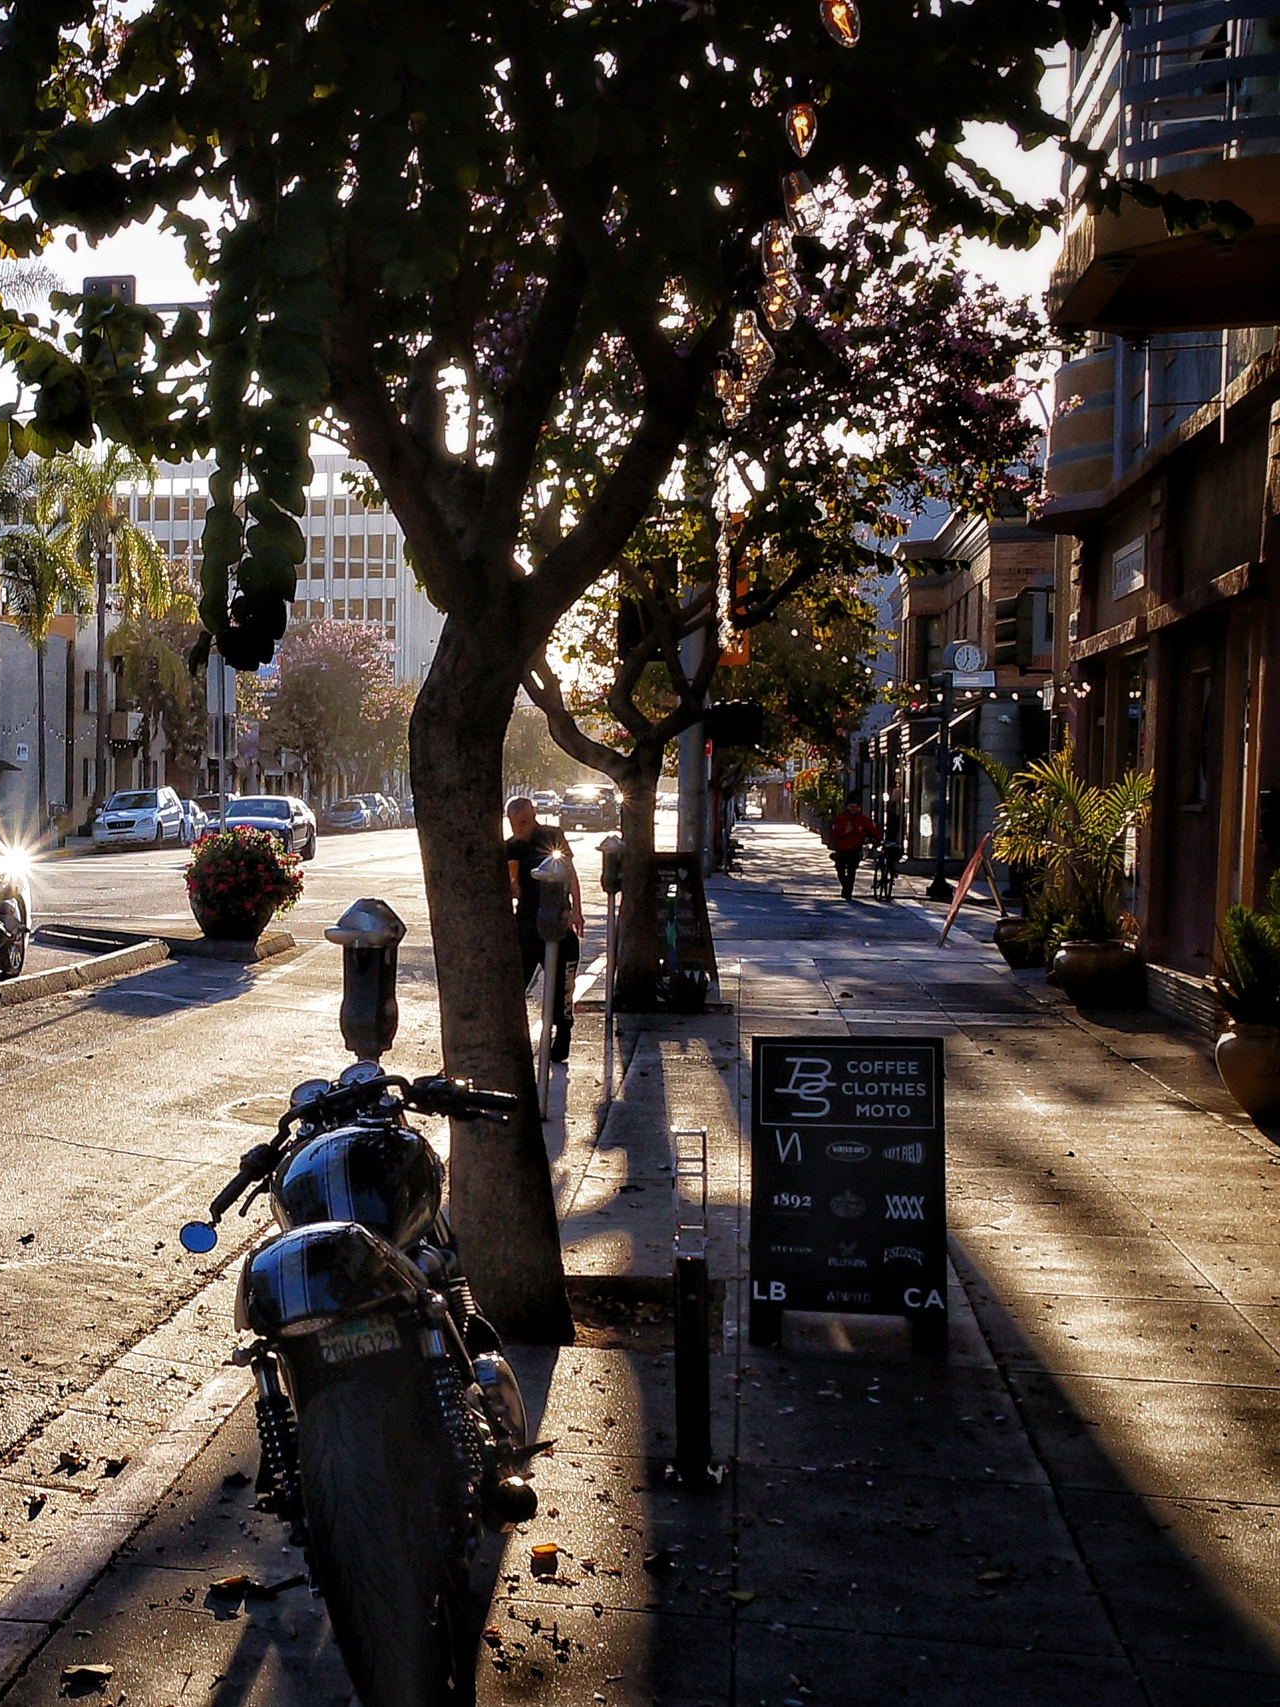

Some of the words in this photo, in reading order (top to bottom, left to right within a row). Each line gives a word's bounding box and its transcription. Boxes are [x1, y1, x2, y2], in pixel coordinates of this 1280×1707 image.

[846, 1060, 919, 1075] COFFEE
[840, 1081, 927, 1097] CLOTHES
[855, 1103, 911, 1118] MOTO
[831, 1145, 865, 1155] vanson
[772, 1192, 812, 1209] 1892
[752, 1279, 787, 1301] LB
[903, 1287, 945, 1309] CA
